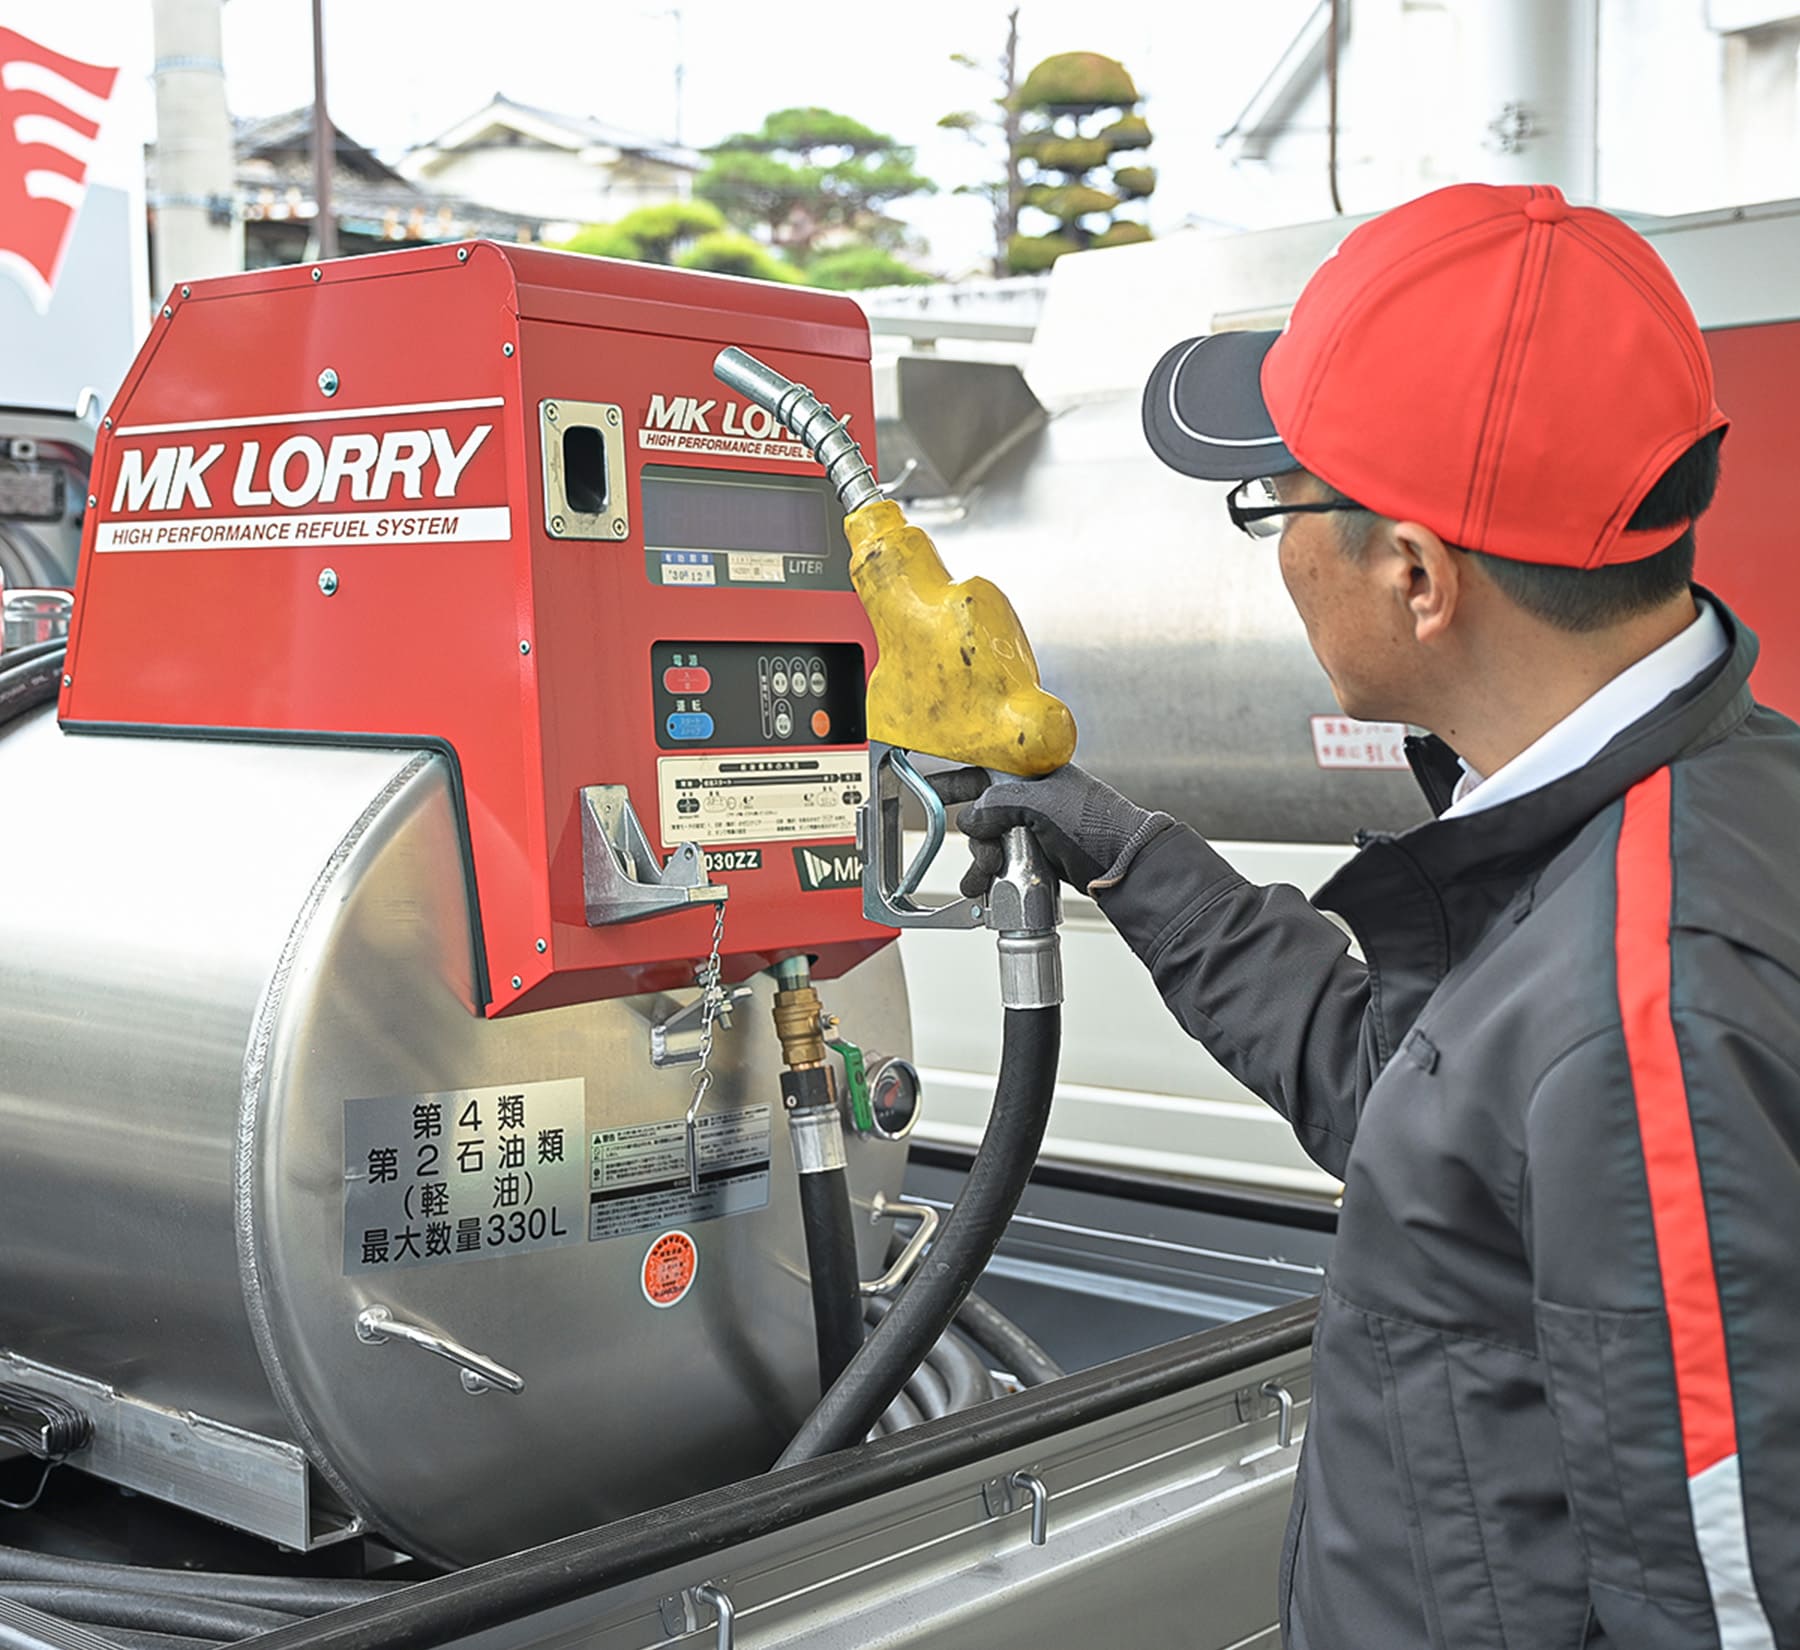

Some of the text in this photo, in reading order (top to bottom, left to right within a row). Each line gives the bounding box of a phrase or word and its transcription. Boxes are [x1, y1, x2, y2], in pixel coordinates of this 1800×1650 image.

[645, 394, 716, 433] MK
[646, 433, 676, 447] HIGH
[678, 435, 762, 455] PERFORMANCE
[763, 442, 803, 459] REFUEL
[110, 424, 494, 513] MK LORRY
[112, 516, 459, 546] HIGH PERFORMANCE REFUEL SYSTEM
[788, 560, 824, 575] LITER
[705, 851, 758, 871] 030ZZ
[412, 1094, 526, 1140] 第4類
[367, 1129, 565, 1185] 第2石油類
[361, 1209, 568, 1265] 最大数量330L
